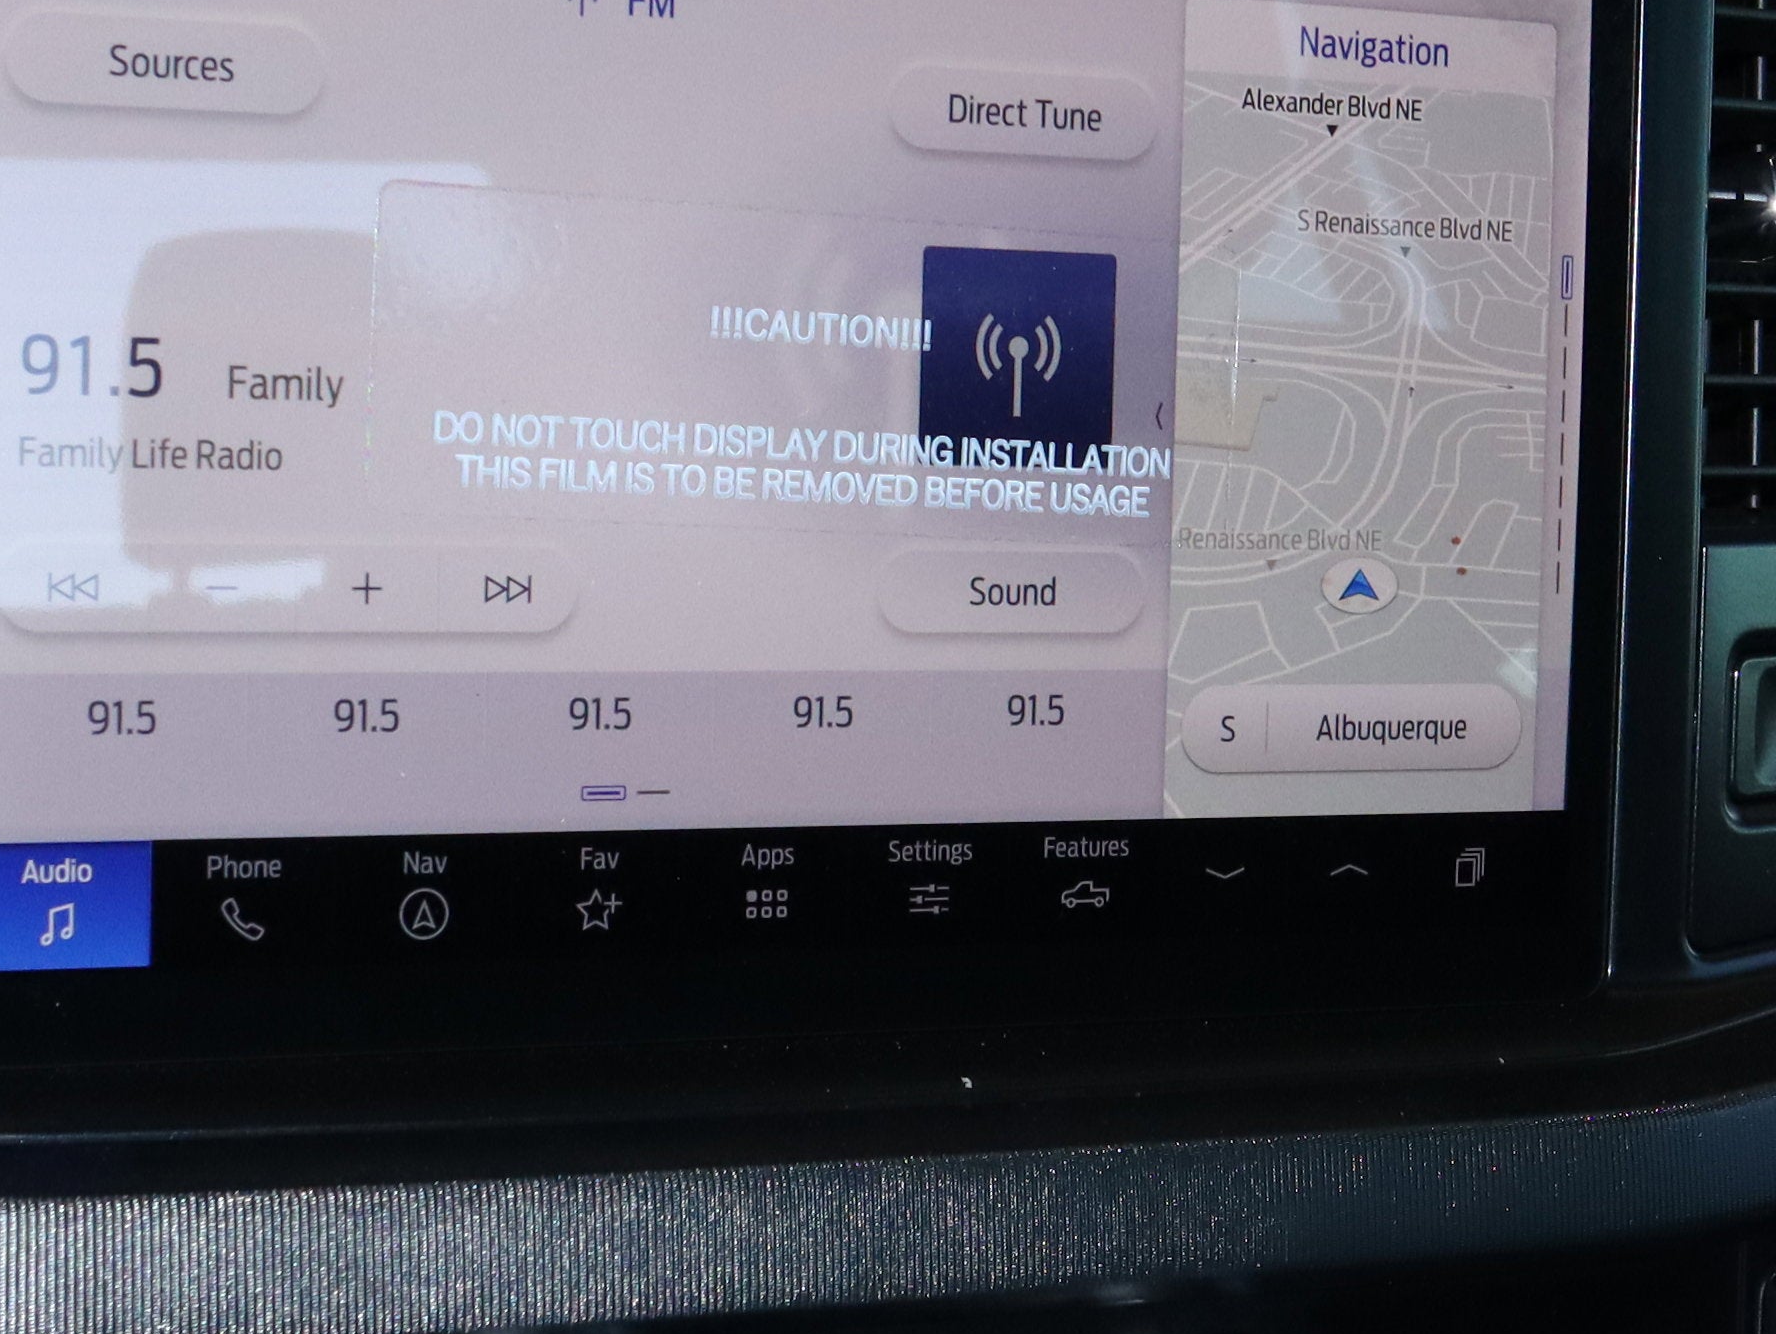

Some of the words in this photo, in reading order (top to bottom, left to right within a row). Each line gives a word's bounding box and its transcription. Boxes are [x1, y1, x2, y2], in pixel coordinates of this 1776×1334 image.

[1300, 25, 1449, 67] Navigation
[110, 45, 234, 82] Sources
[949, 94, 1027, 129] Direct
[1036, 99, 1102, 132] Tune
[1241, 88, 1343, 117] Alexander
[1347, 96, 1392, 120] Blvd
[1395, 100, 1423, 122] NE
[1297, 209, 1310, 232] S
[1314, 211, 1436, 238] Renaissance
[1440, 218, 1481, 240] Blvd
[1486, 220, 1513, 242] NE
[22, 334, 163, 398] 91.5
[228, 365, 344, 407] Family
[18, 435, 123, 473] Family
[132, 438, 188, 470] Life
[196, 441, 283, 471] Radio
[433, 410, 485, 444] DO
[490, 413, 564, 449] NOT
[570, 416, 686, 454] TOUCH
[693, 423, 828, 463] DISPLAY
[832, 430, 954, 466] DURING
[961, 436, 1170, 479] INSTALLATION
[455, 454, 532, 491] THIS
[539, 458, 617, 493] FILM
[625, 462, 655, 495] IS
[661, 464, 706, 497] TO
[713, 466, 756, 500] BE
[762, 468, 918, 506] REMOVED
[925, 476, 1045, 513] BEFORE
[1050, 482, 1151, 518] USAGE
[1308, 529, 1350, 551] Blvd
[1356, 531, 1382, 551] NE
[969, 577, 1057, 608] Sound
[88, 700, 156, 735] 91.5
[334, 699, 400, 733] 91.5
[568, 697, 632, 731] 91.5
[793, 696, 854, 729] 91.5
[1007, 694, 1066, 727] 91.5
[1220, 716, 1236, 742] S
[1317, 715, 1468, 746] Albuquerque
[403, 851, 447, 875] Nav
[579, 847, 620, 871] Fav
[741, 842, 795, 870] Apps
[888, 838, 973, 867] Settings
[1043, 835, 1130, 859] Features
[21, 858, 93, 885] Audio
[206, 855, 282, 880] Phone
